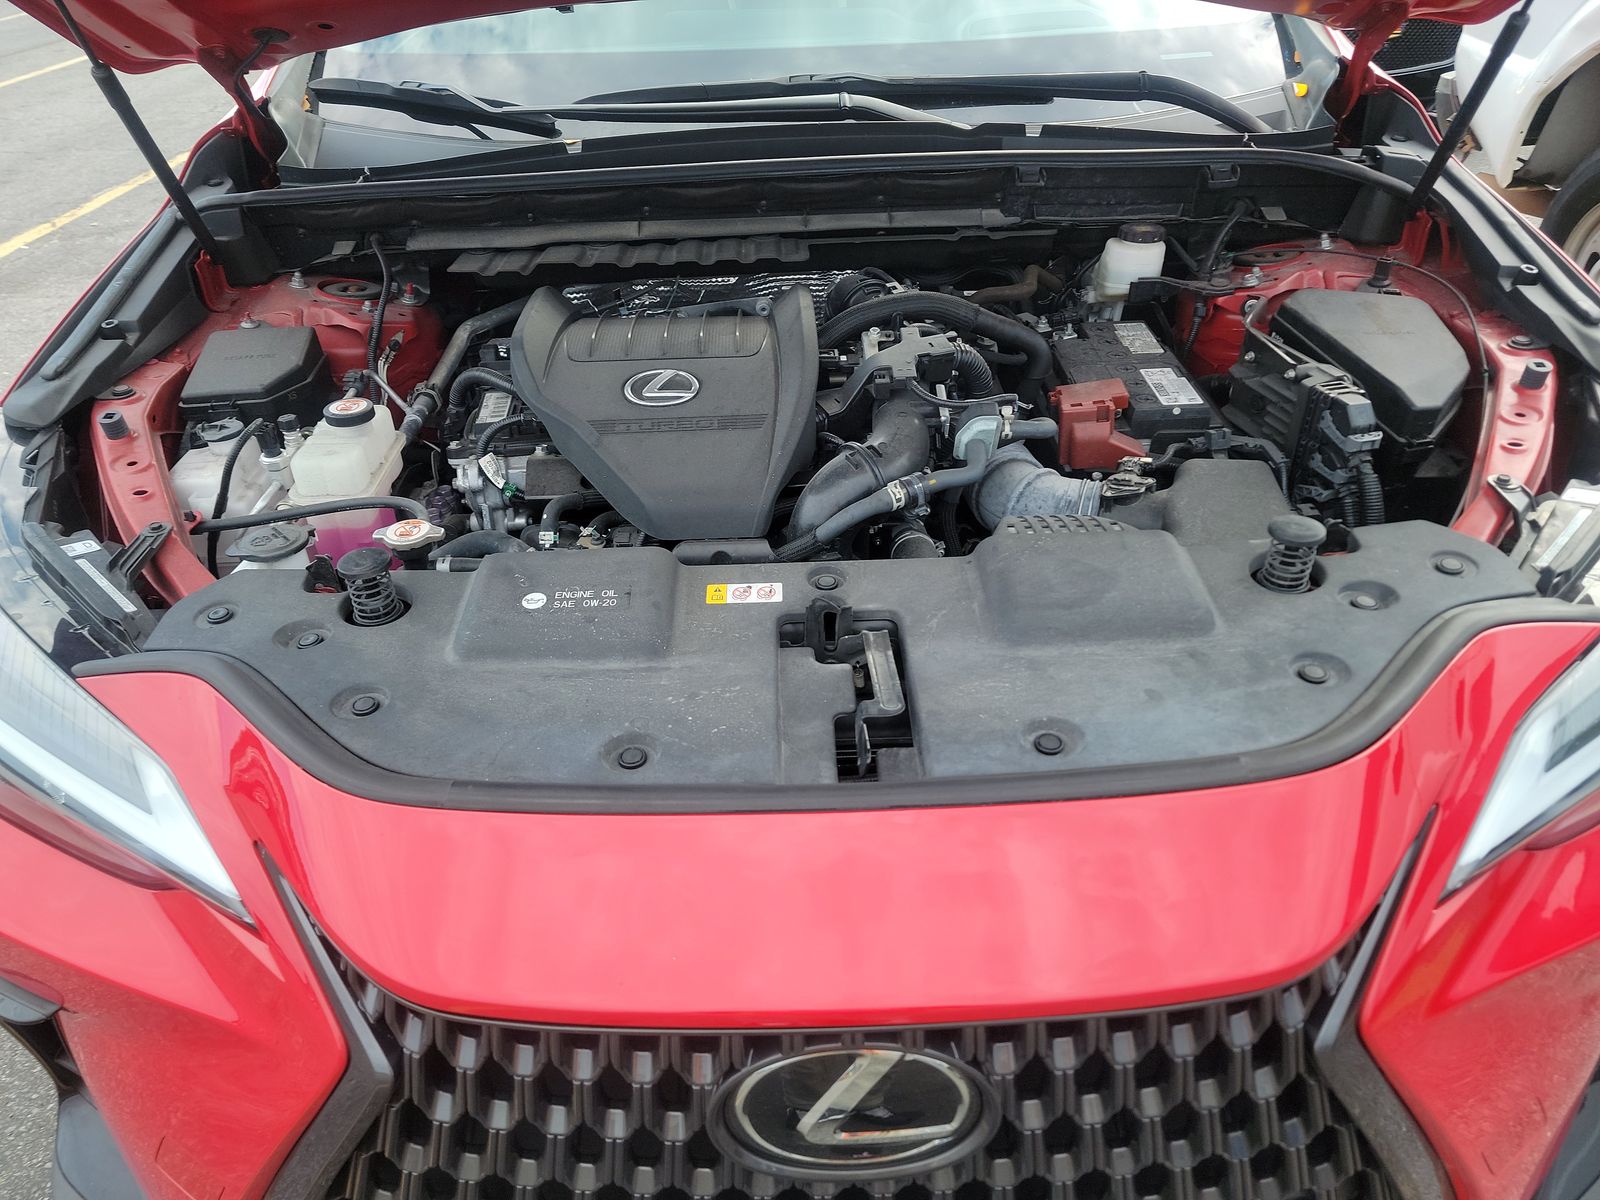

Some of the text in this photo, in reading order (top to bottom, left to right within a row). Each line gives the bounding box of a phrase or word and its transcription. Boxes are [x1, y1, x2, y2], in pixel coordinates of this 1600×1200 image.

[554, 589, 619, 599] ENGINE OIL
[553, 598, 617, 608] SAE 0W-20
